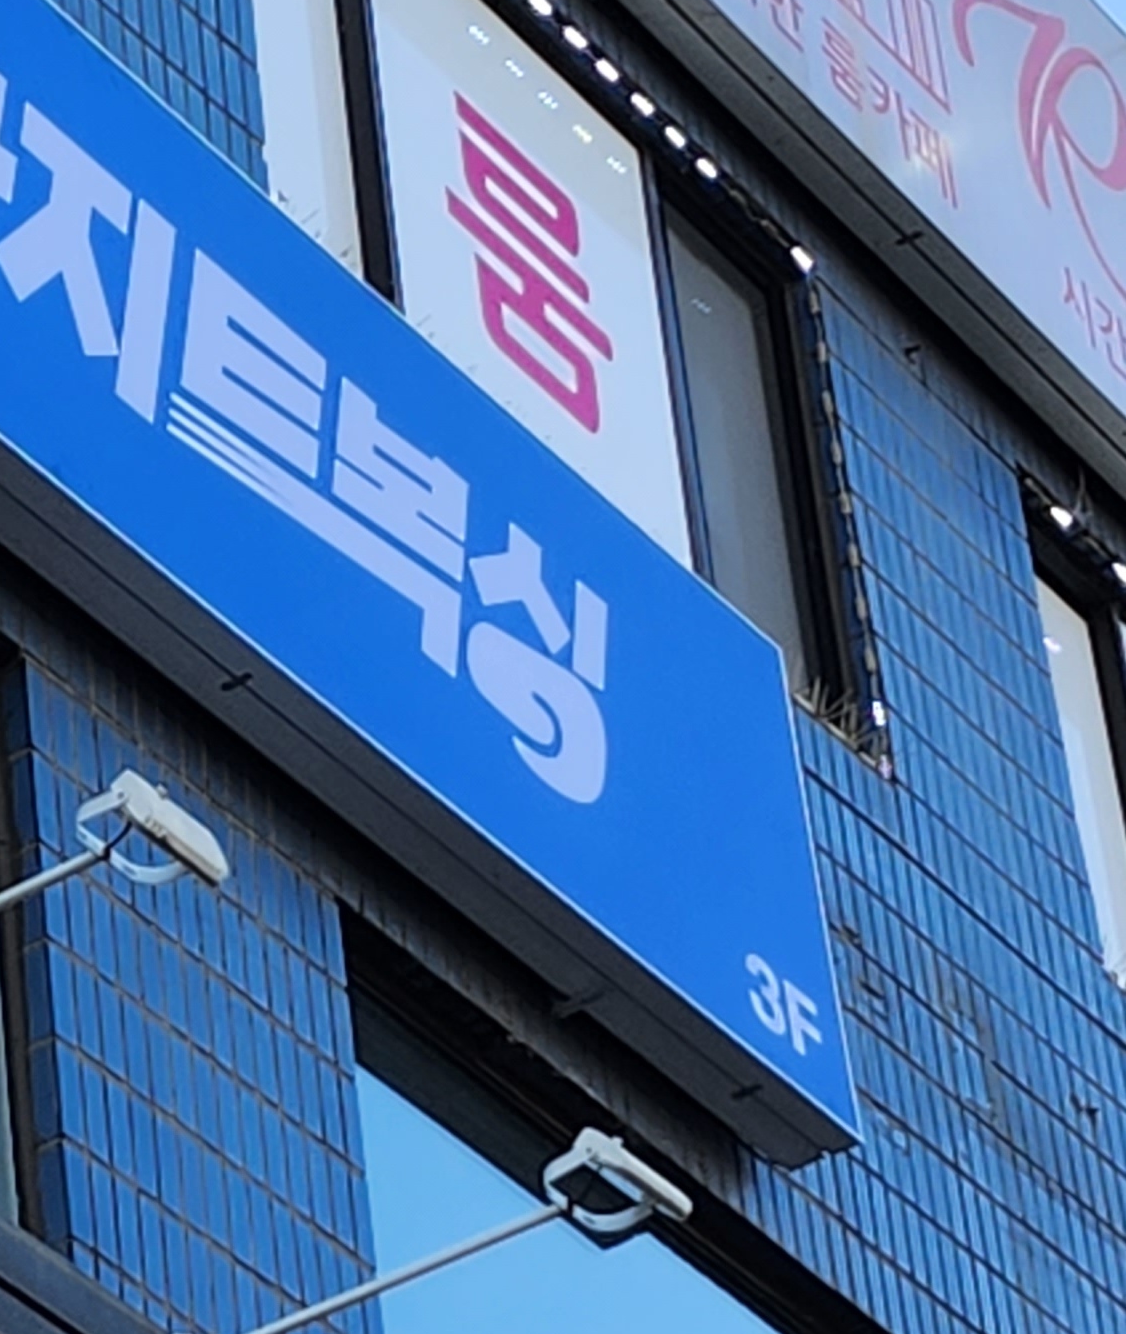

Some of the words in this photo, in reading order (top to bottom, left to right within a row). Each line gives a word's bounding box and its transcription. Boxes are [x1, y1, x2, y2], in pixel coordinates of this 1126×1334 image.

[822, 17, 958, 210] 룸카페
[445, 90, 615, 434] 룸
[745, 952, 823, 1056] 3F
